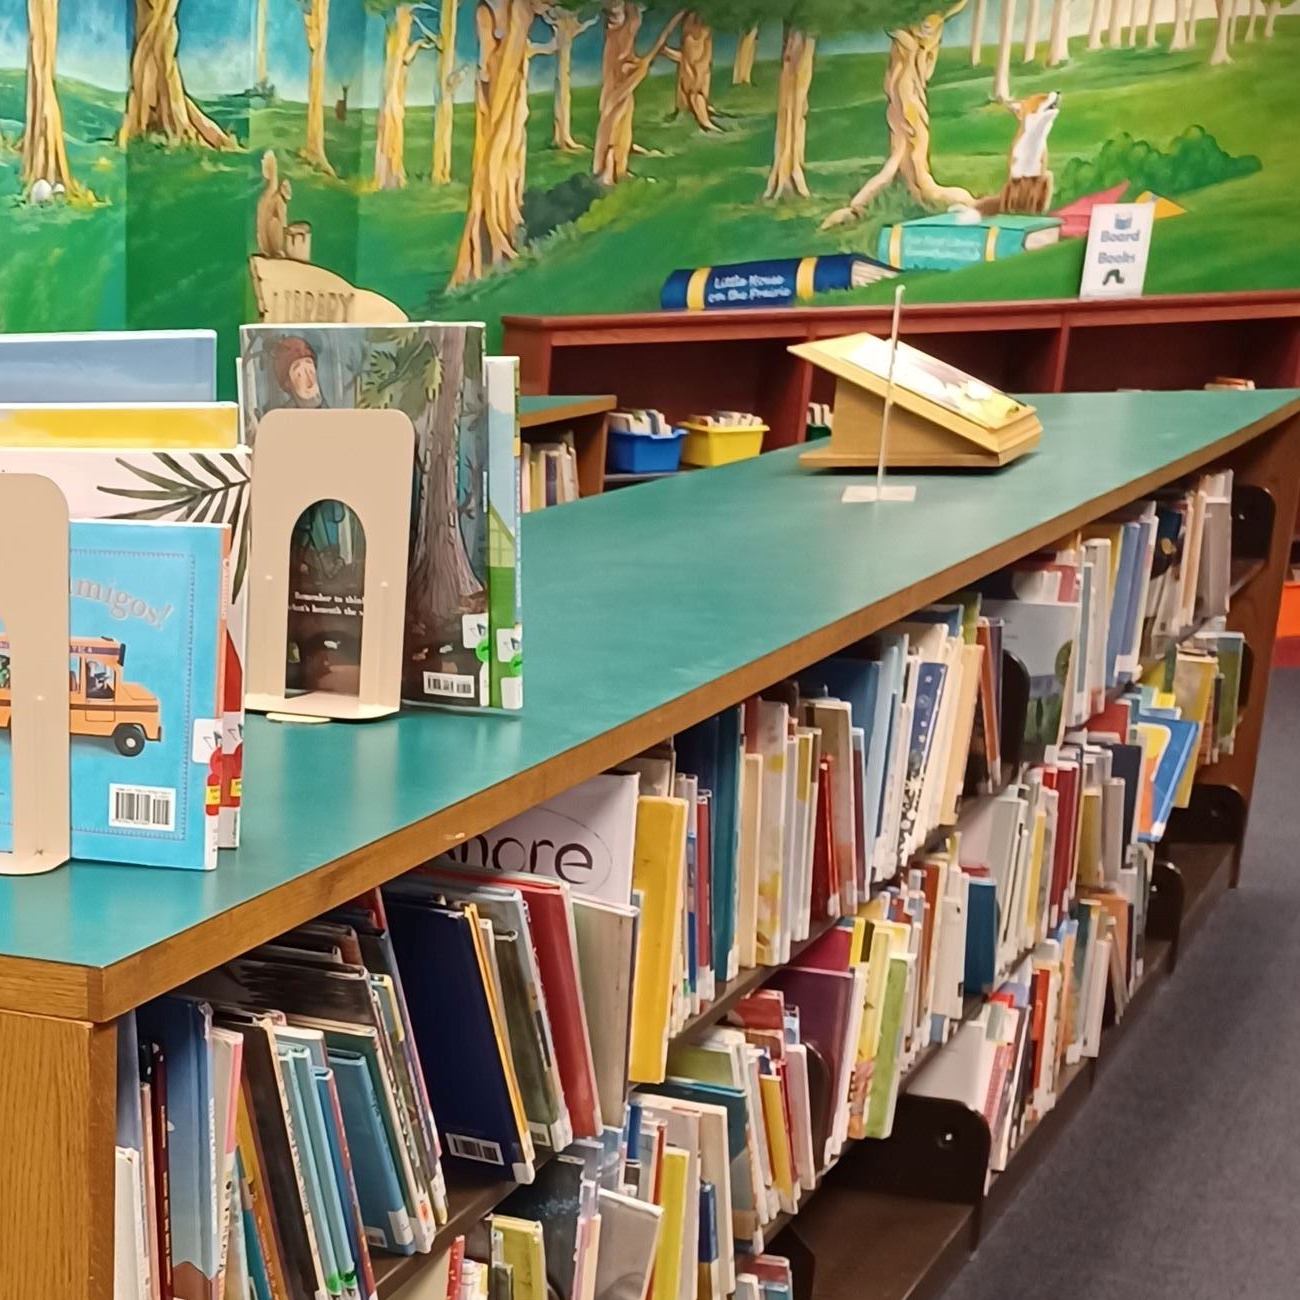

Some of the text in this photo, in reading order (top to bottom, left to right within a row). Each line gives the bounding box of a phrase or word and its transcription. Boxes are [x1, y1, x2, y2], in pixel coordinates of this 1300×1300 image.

[1100, 229, 1140, 242] Board
[1098, 250, 1135, 264] Books
[714, 274, 747, 289] Little
[708, 293, 726, 303] on
[749, 286, 792, 300] Prairie
[69, 576, 175, 631] migos!
